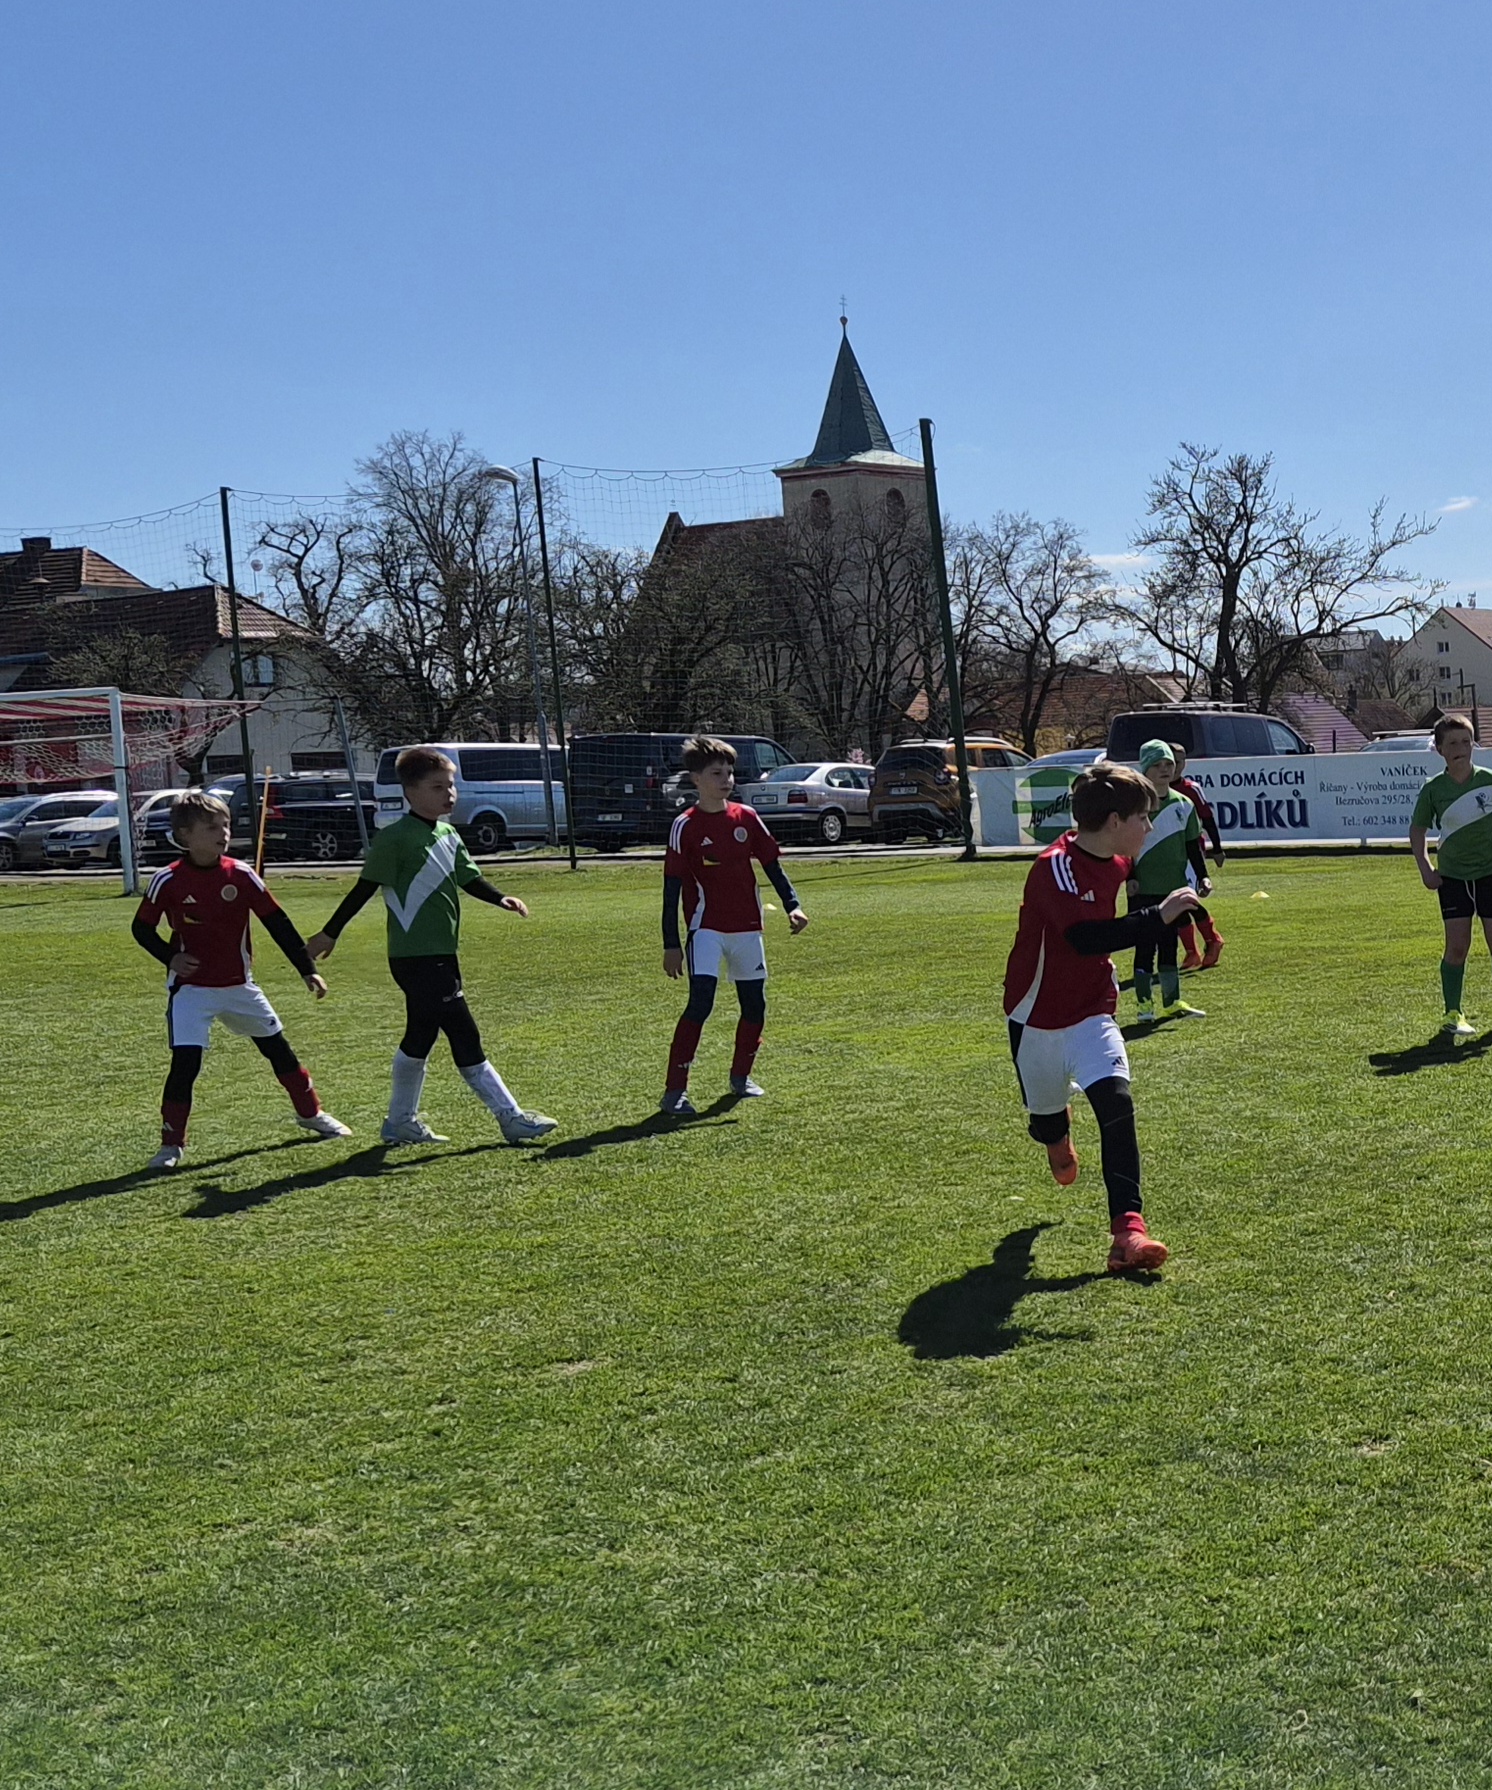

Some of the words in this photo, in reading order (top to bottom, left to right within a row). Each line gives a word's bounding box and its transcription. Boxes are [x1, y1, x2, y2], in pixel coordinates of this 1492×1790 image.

[1380, 764, 1428, 777] VANÍČEK
[1220, 767, 1305, 788] DOMÁCÍCH
[1320, 781, 1348, 795] Říčany
[1356, 781, 1388, 794] Výroba
[1363, 815, 1379, 825] 602
[1380, 815, 1397, 825] 348
